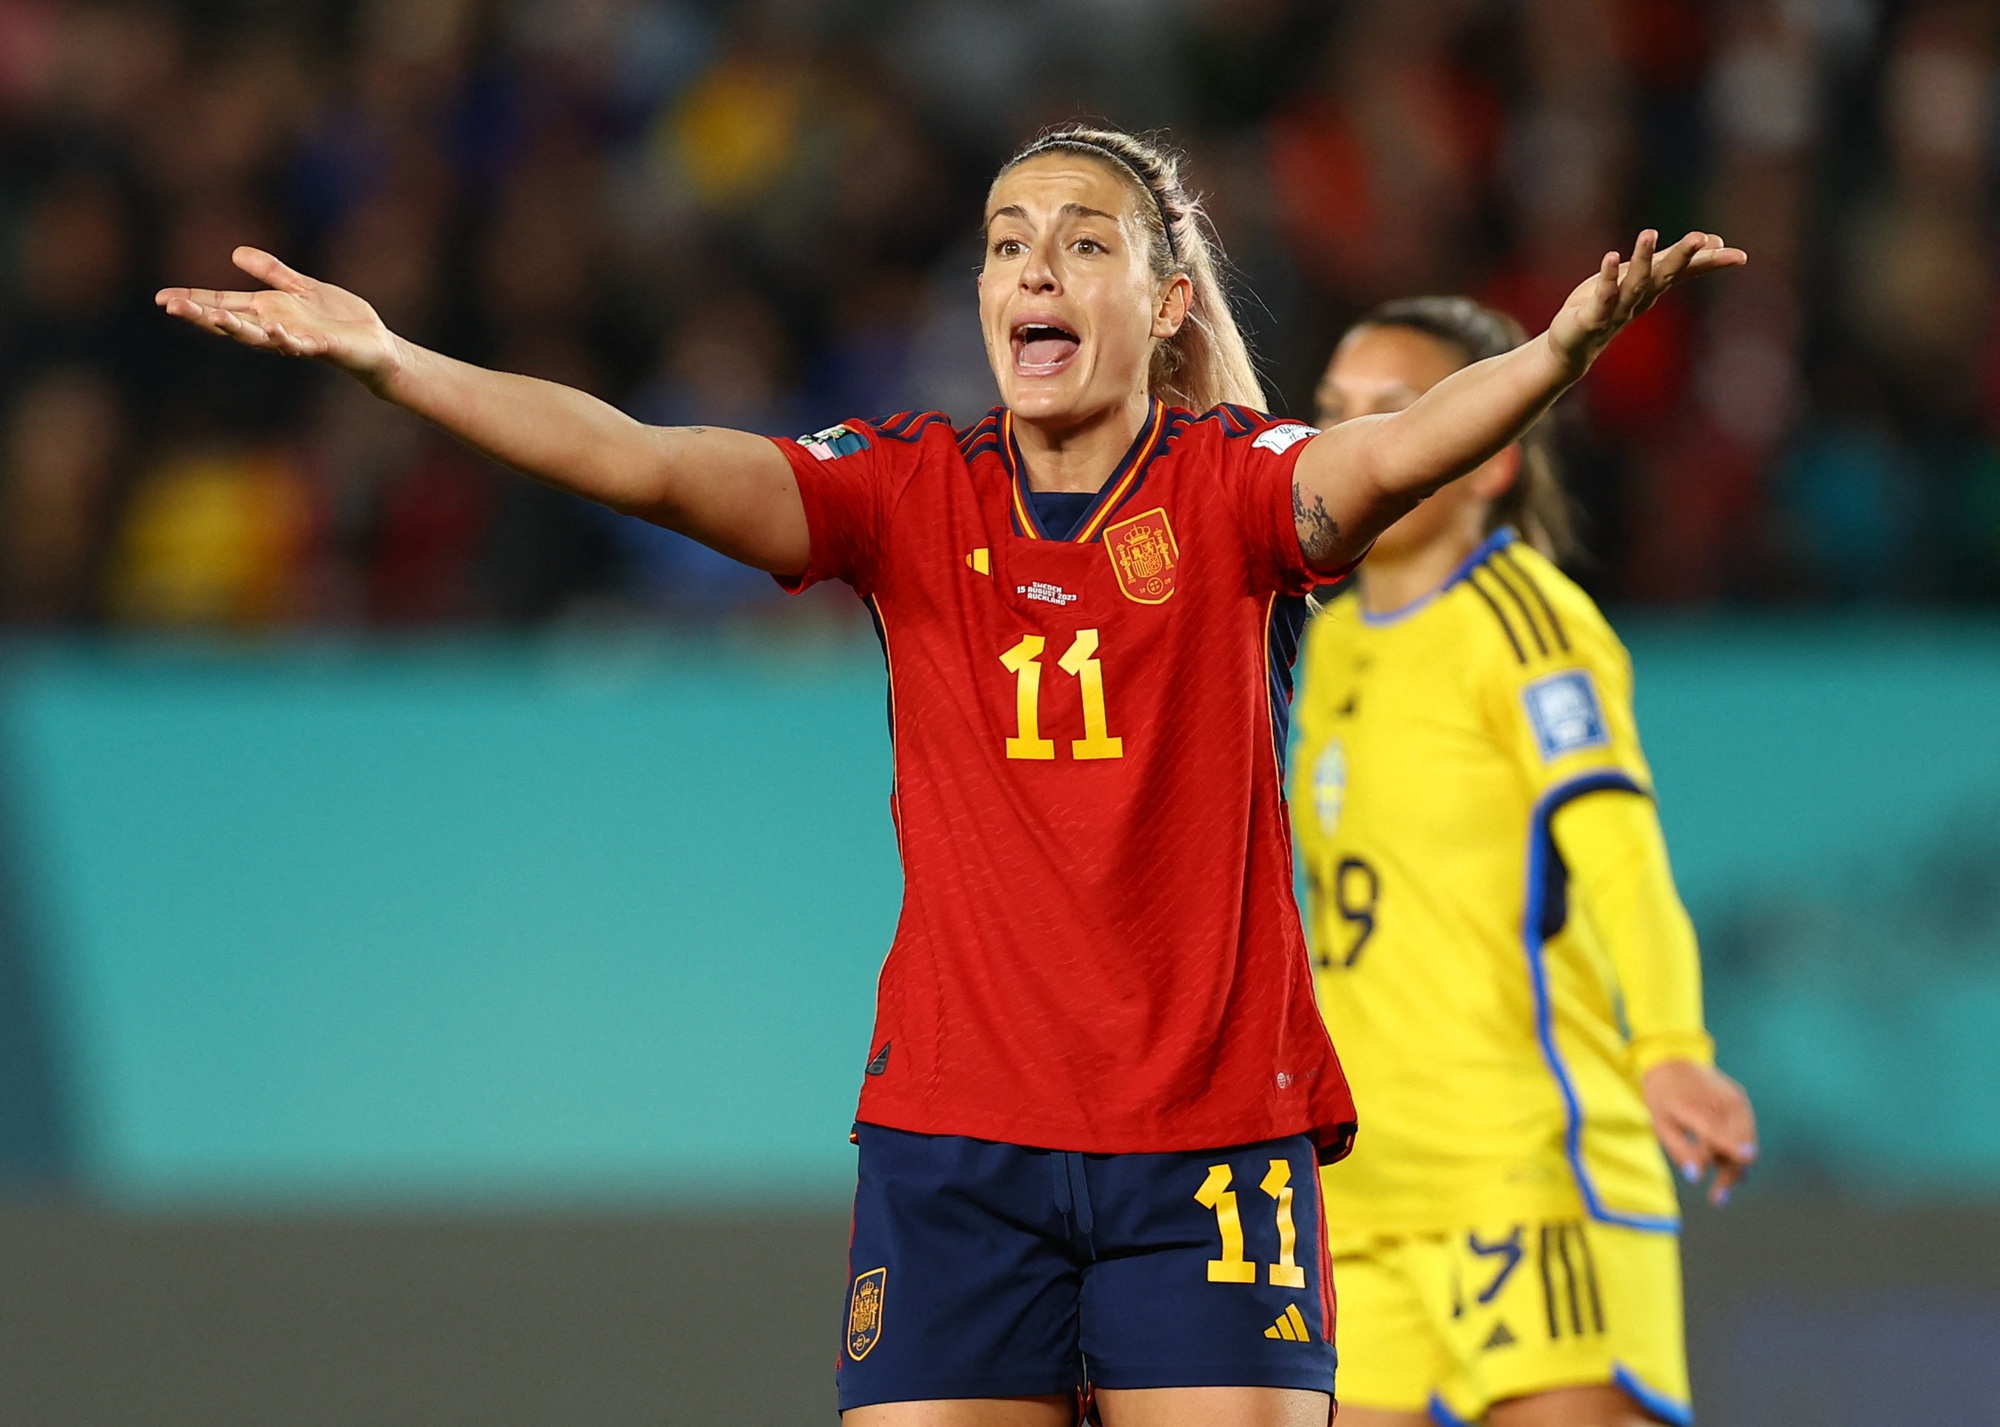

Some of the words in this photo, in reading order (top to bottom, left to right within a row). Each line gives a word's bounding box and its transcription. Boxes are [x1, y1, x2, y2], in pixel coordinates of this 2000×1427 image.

[1017, 585, 1026, 594] 15
[1027, 586, 1056, 598] AUGUST
[1057, 593, 1077, 601] 2023
[1032, 581, 1062, 593] SWEDEN
[1027, 592, 1066, 606] AUCKLAND
[998, 628, 1124, 760] 11
[1193, 1159, 1306, 1289] 11
